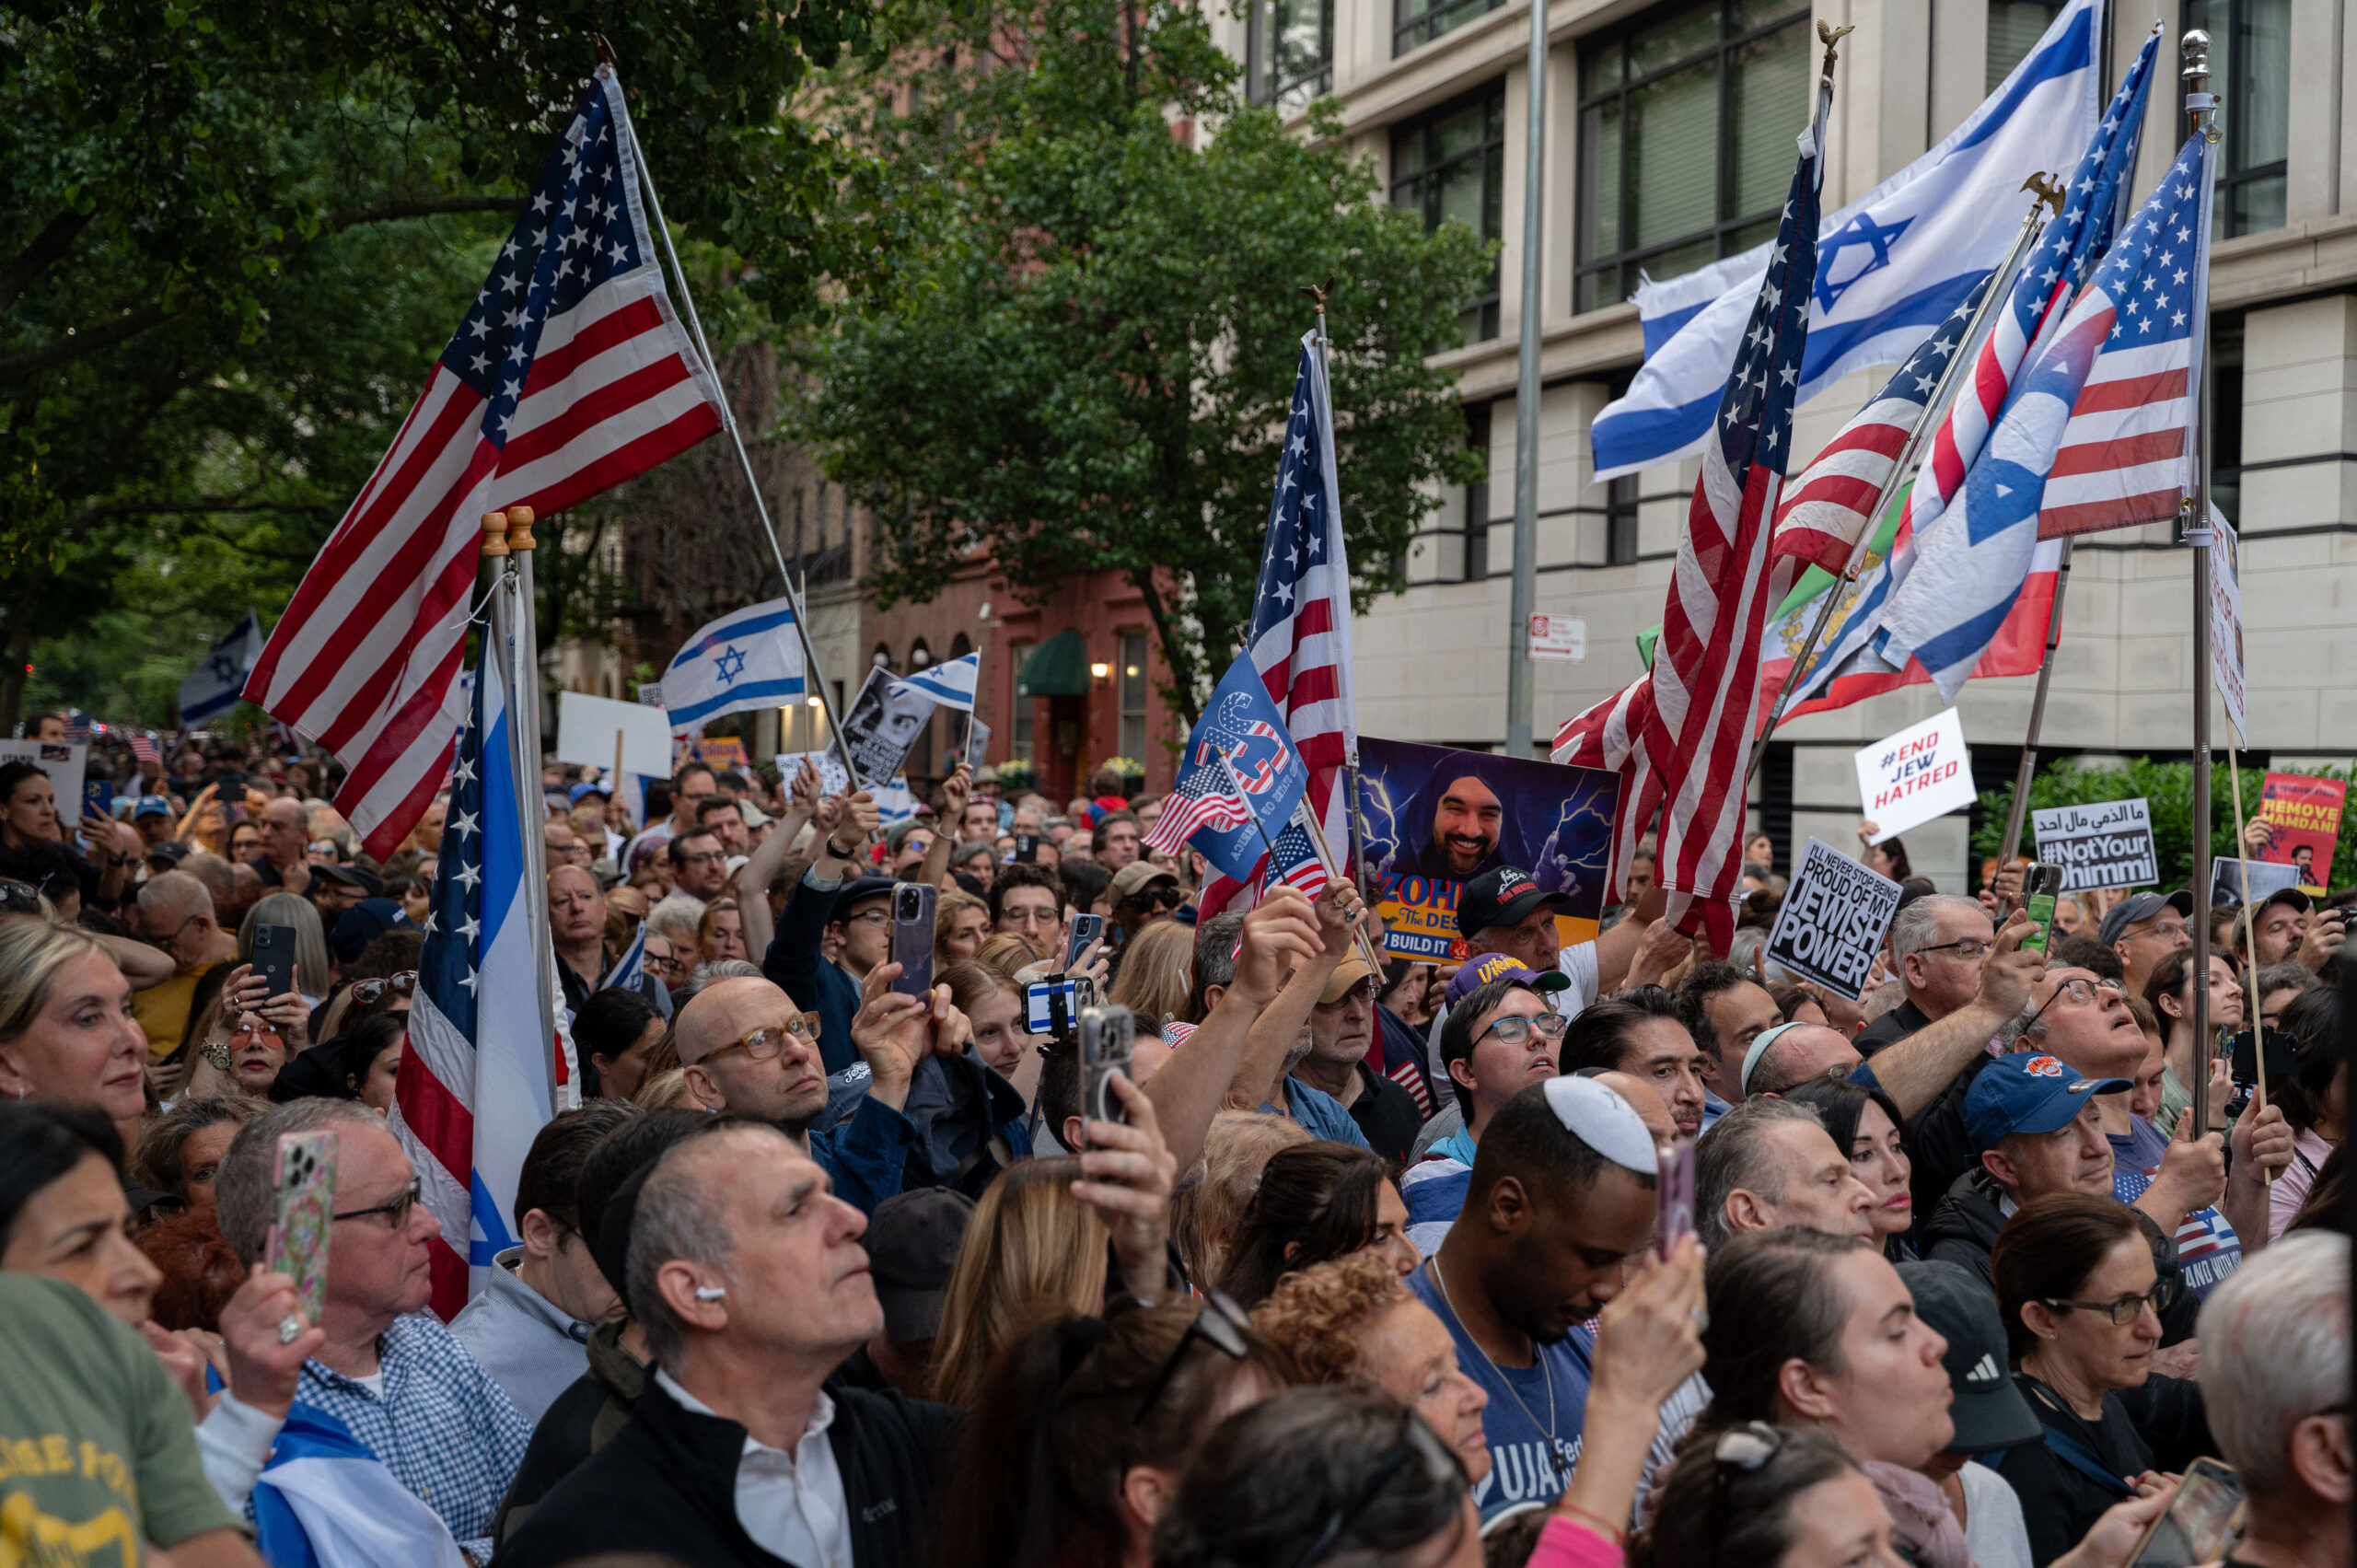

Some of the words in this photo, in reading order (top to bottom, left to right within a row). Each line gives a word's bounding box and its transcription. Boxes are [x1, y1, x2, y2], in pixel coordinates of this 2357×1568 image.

[1880, 731, 1939, 769] #END
[1891, 750, 1935, 784] JEW
[1874, 761, 1958, 809] HATRED
[2261, 811, 2338, 834] MAMDANI
[2263, 798, 2339, 821] REMOVE
[2042, 834, 2148, 864] #NotYour
[1377, 871, 1468, 912] ZOH
[1802, 857, 1852, 898] PROUD
[1851, 885, 1873, 907] OF
[1868, 894, 1894, 920] MY
[1810, 843, 1825, 862] I'LL
[1824, 853, 1854, 877] NEVER
[1852, 868, 1875, 887] STOP
[1873, 879, 1899, 902] BEING
[1496, 890, 1514, 905] FOR
[1399, 907, 1423, 926] The
[1426, 912, 1459, 931] DES
[1787, 877, 1887, 957] JEWISH
[1390, 933, 1433, 953] BUILD
[1434, 939, 1448, 955] IT
[1774, 912, 1873, 990] POWER
[1494, 1441, 1561, 1501] UJA
